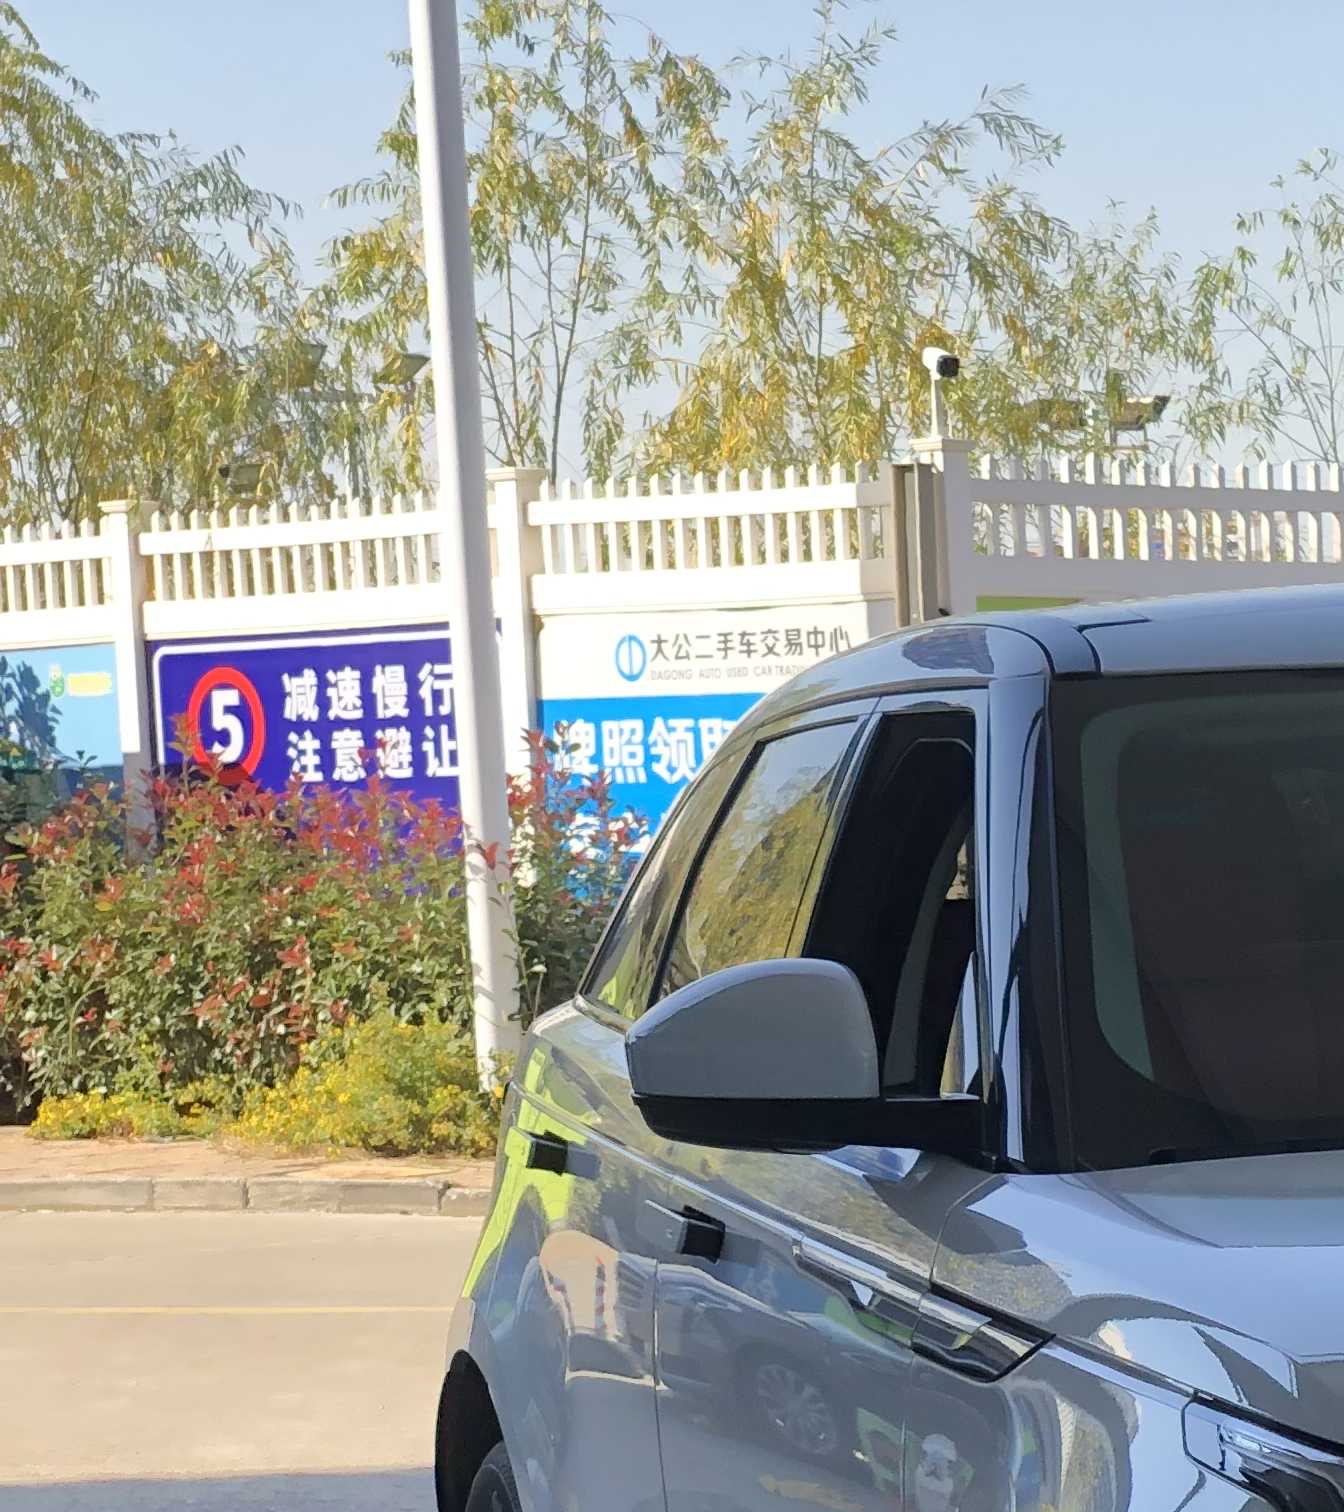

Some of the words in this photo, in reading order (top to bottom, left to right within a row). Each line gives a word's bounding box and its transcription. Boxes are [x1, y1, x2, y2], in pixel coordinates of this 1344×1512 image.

[650, 626, 853, 662] 大公二手车交易中心
[650, 668, 693, 681] DAGONG
[698, 667, 721, 679] AUTO
[726, 667, 748, 678] USED
[753, 665, 773, 677] CAR
[281, 662, 455, 722] 减速慢行
[210, 688, 245, 764] 5
[286, 723, 459, 783] 注意避让
